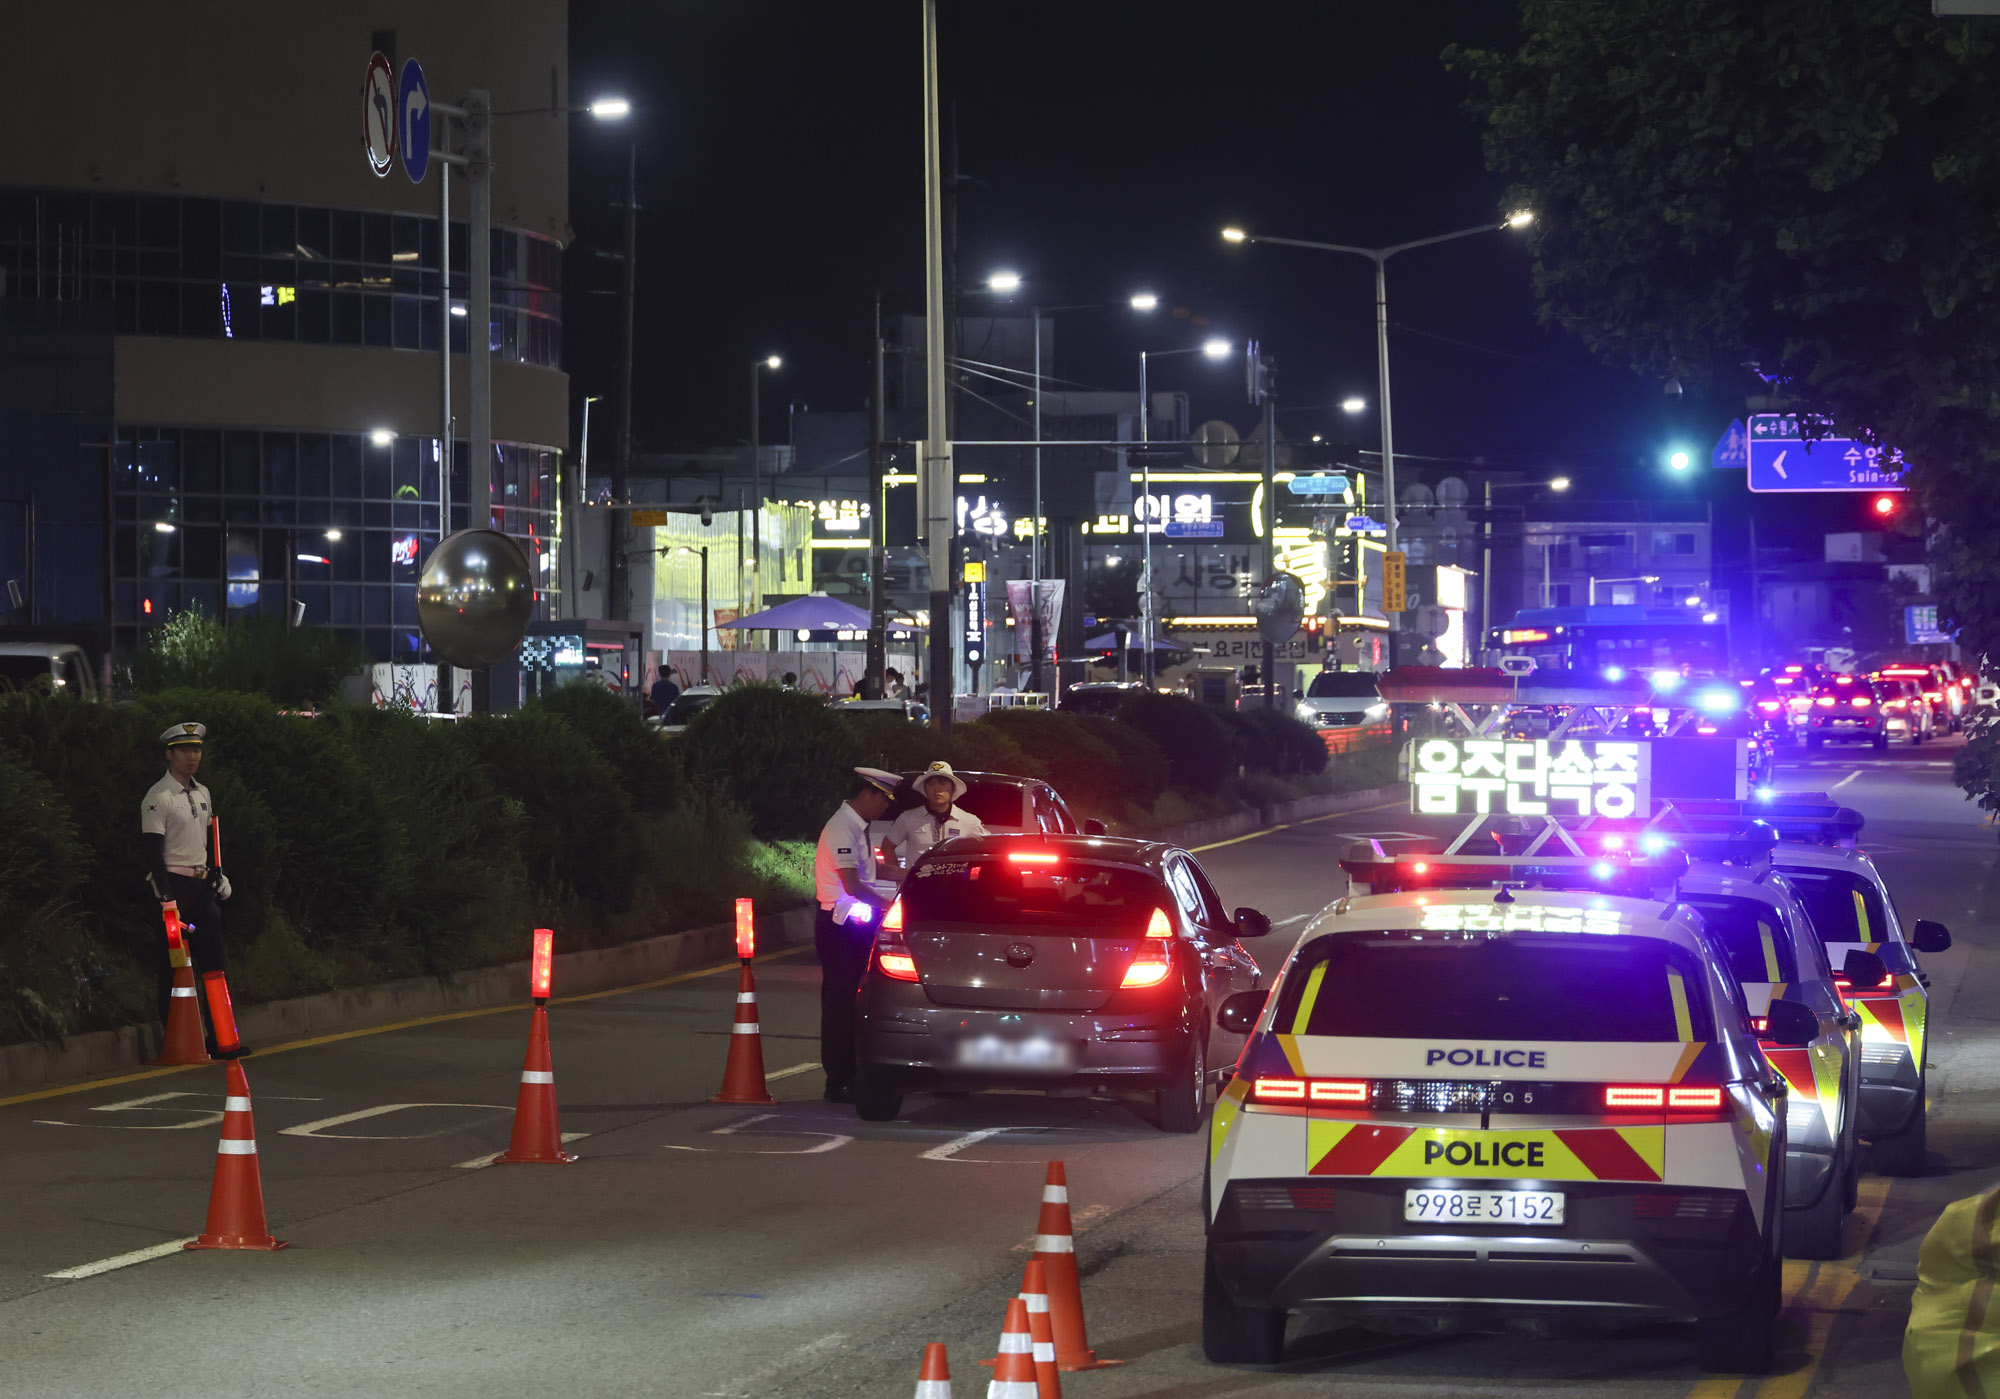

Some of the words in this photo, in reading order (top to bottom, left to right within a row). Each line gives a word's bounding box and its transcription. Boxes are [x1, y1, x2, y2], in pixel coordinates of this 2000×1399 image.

[1415, 739, 1638, 818] 음주단속중
[1427, 1049, 1545, 1068] POLICE
[1524, 1093, 1533, 1104] 5
[1424, 1140, 1544, 1167] POLICE
[1415, 1194, 1482, 1217] 998로
[1489, 1195, 1554, 1219] 3152
